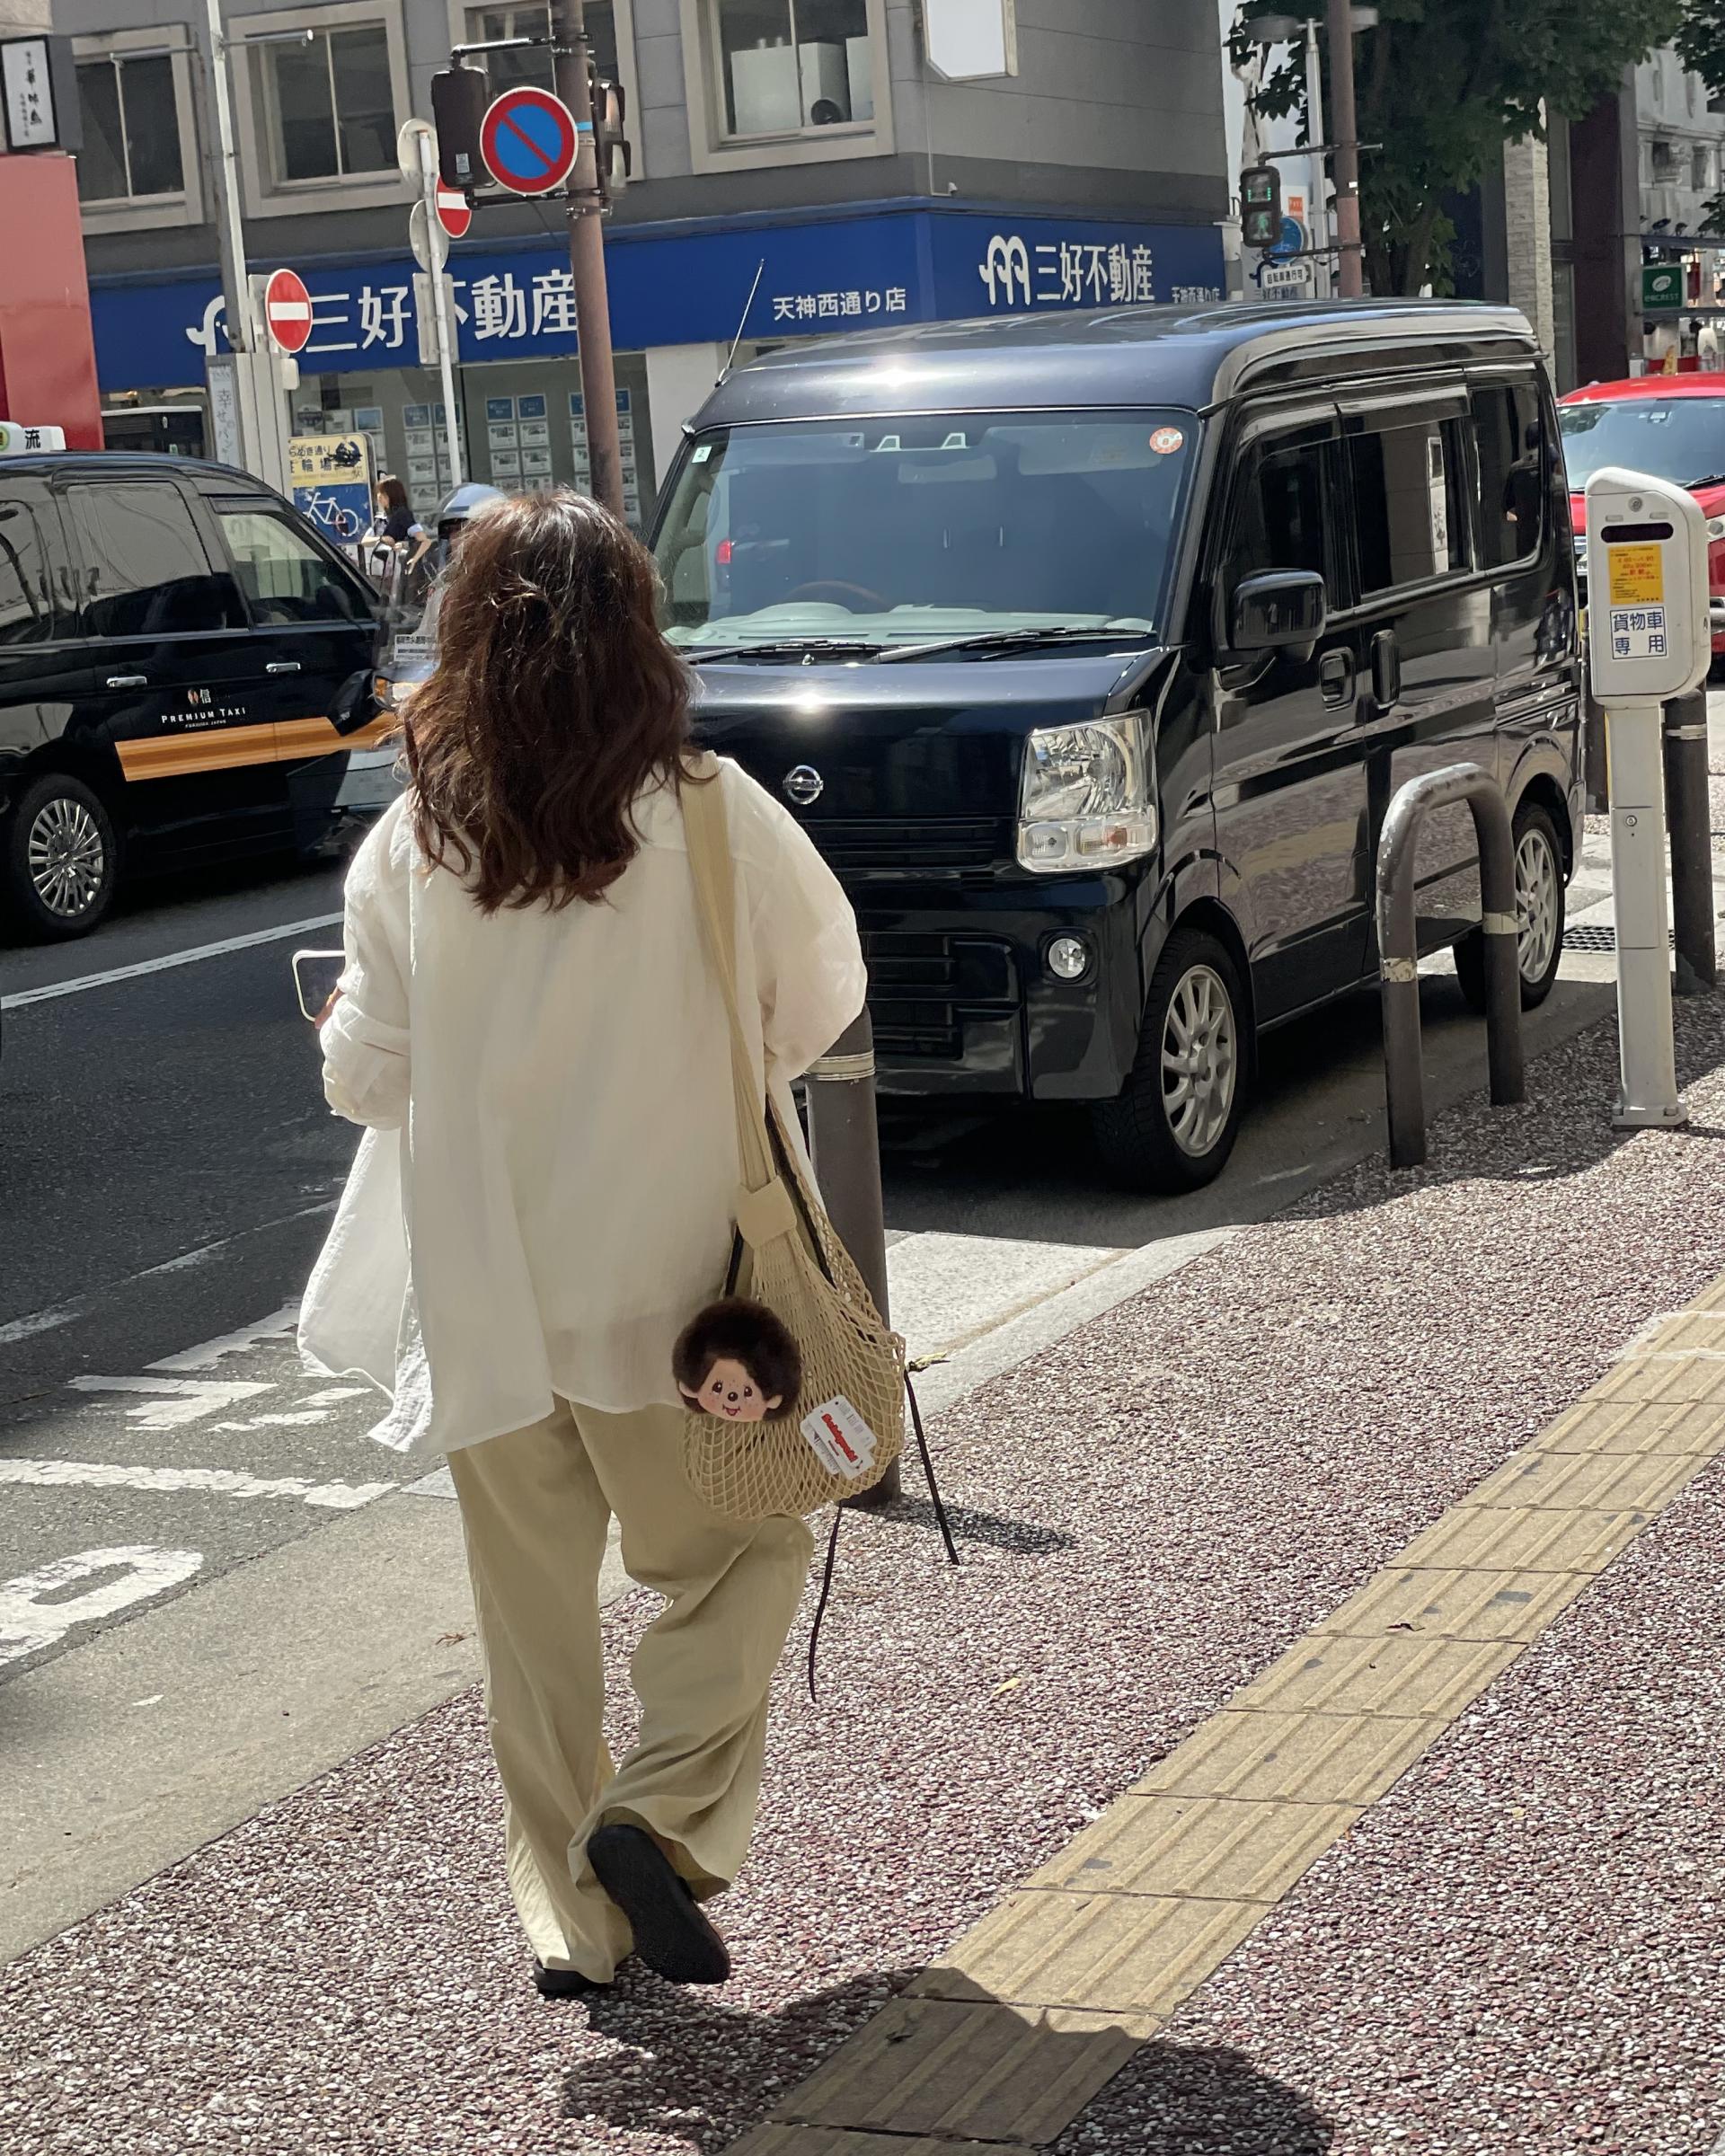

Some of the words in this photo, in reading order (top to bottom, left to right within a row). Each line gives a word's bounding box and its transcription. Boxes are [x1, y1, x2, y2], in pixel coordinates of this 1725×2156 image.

[1036, 242, 1154, 302] 三好不動産
[773, 287, 907, 322] 天神西通り店
[1613, 611, 1663, 632] 貨物車
[1614, 634, 1664, 655] 専用
[219, 707, 246, 718] TAXI
